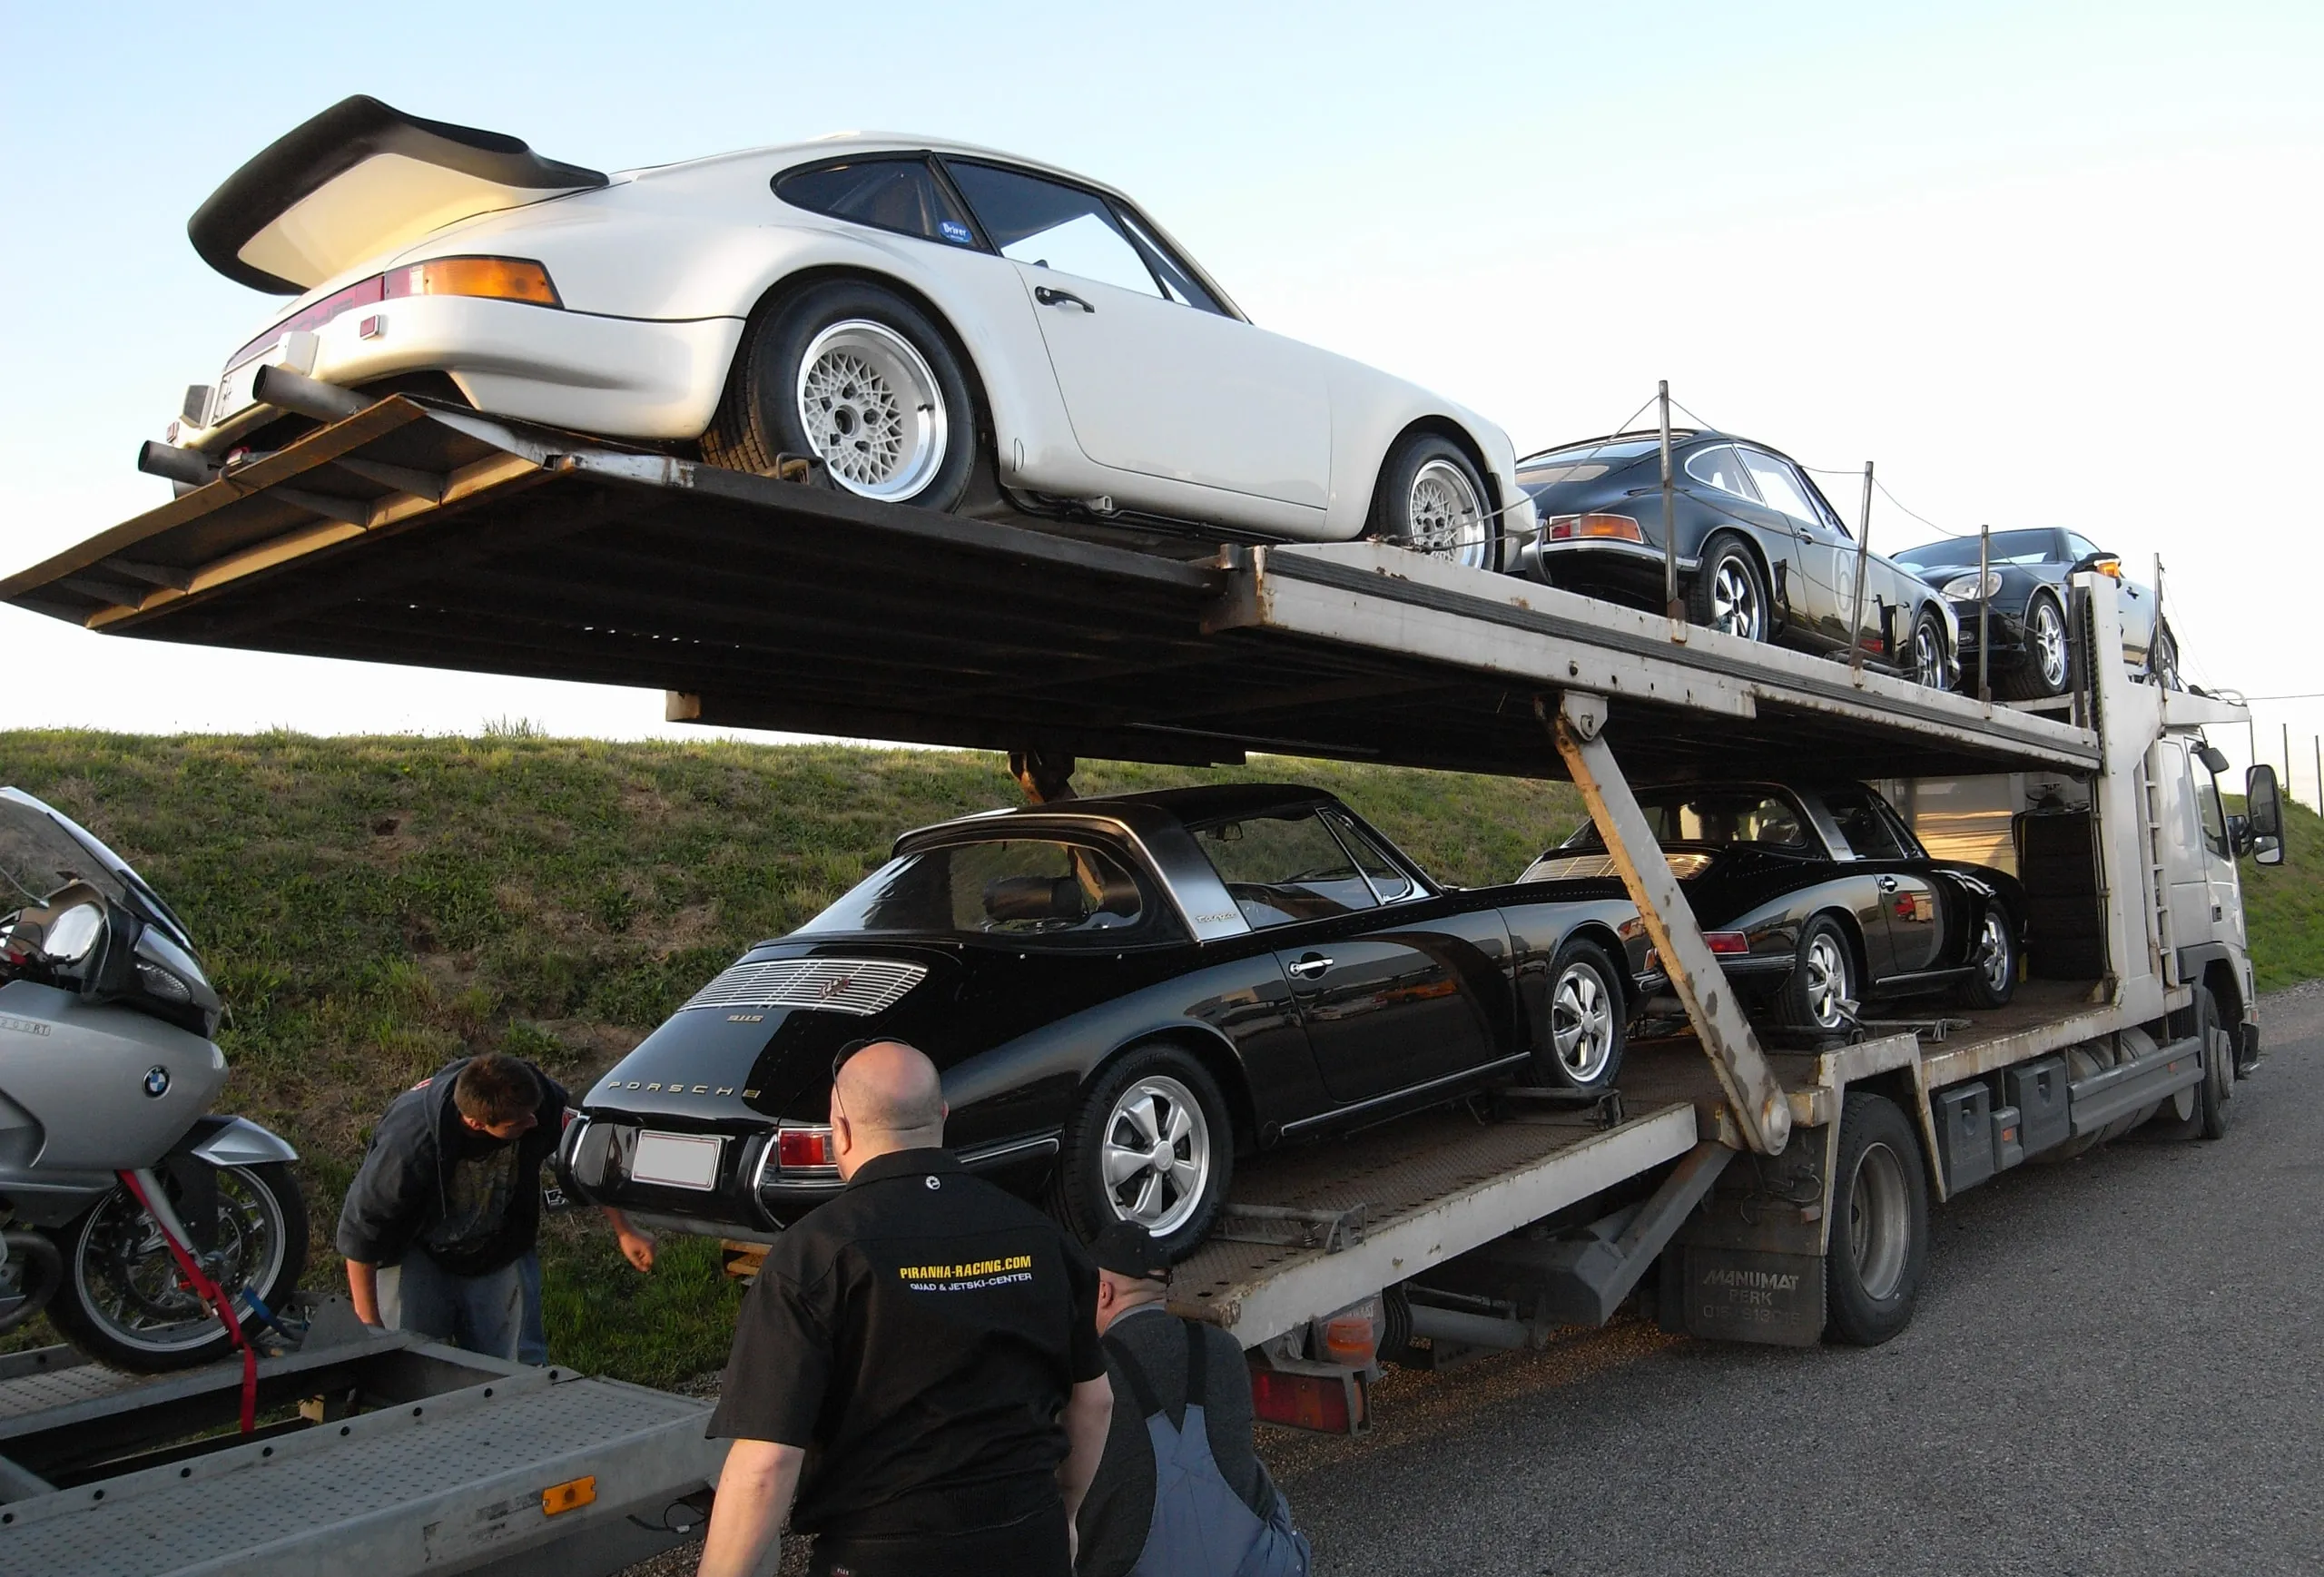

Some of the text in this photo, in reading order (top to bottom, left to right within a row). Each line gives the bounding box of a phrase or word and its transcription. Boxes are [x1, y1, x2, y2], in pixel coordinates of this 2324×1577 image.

[606, 1081, 761, 1099] PORSCHE
[900, 1255, 1032, 1279] PIRANHA-RACING.COM
[910, 1272, 1033, 1292] QUAD & JETSKI-CENTER
[1703, 1270, 1799, 1290] MANUMAT
